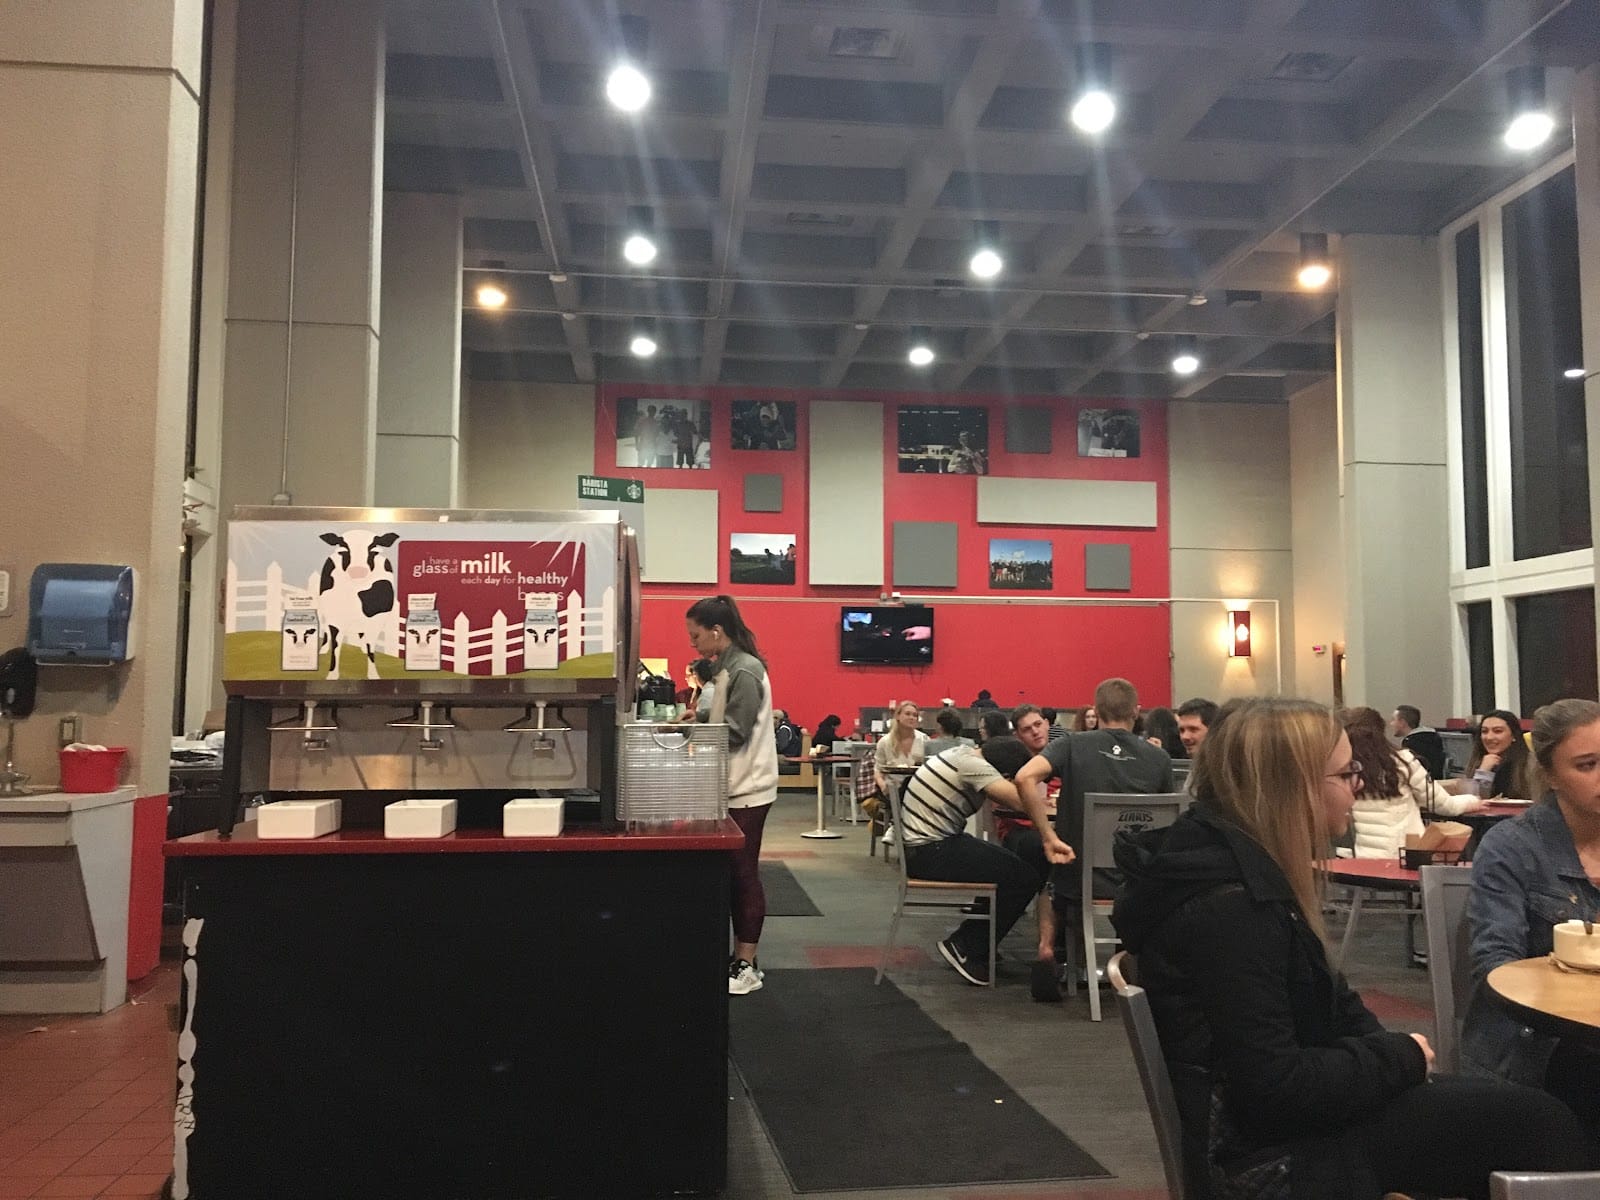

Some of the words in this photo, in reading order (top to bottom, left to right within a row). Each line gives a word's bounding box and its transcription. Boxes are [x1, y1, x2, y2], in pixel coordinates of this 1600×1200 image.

[582, 478, 608, 489] BARISTA
[582, 486, 608, 497] STATION
[413, 560, 449, 577] glass
[449, 564, 458, 574] of
[461, 551, 512, 574] milk
[429, 556, 450, 565] have
[461, 575, 482, 584] each
[484, 575, 501, 586] day
[503, 575, 516, 584] for
[517, 571, 568, 588] healthy
